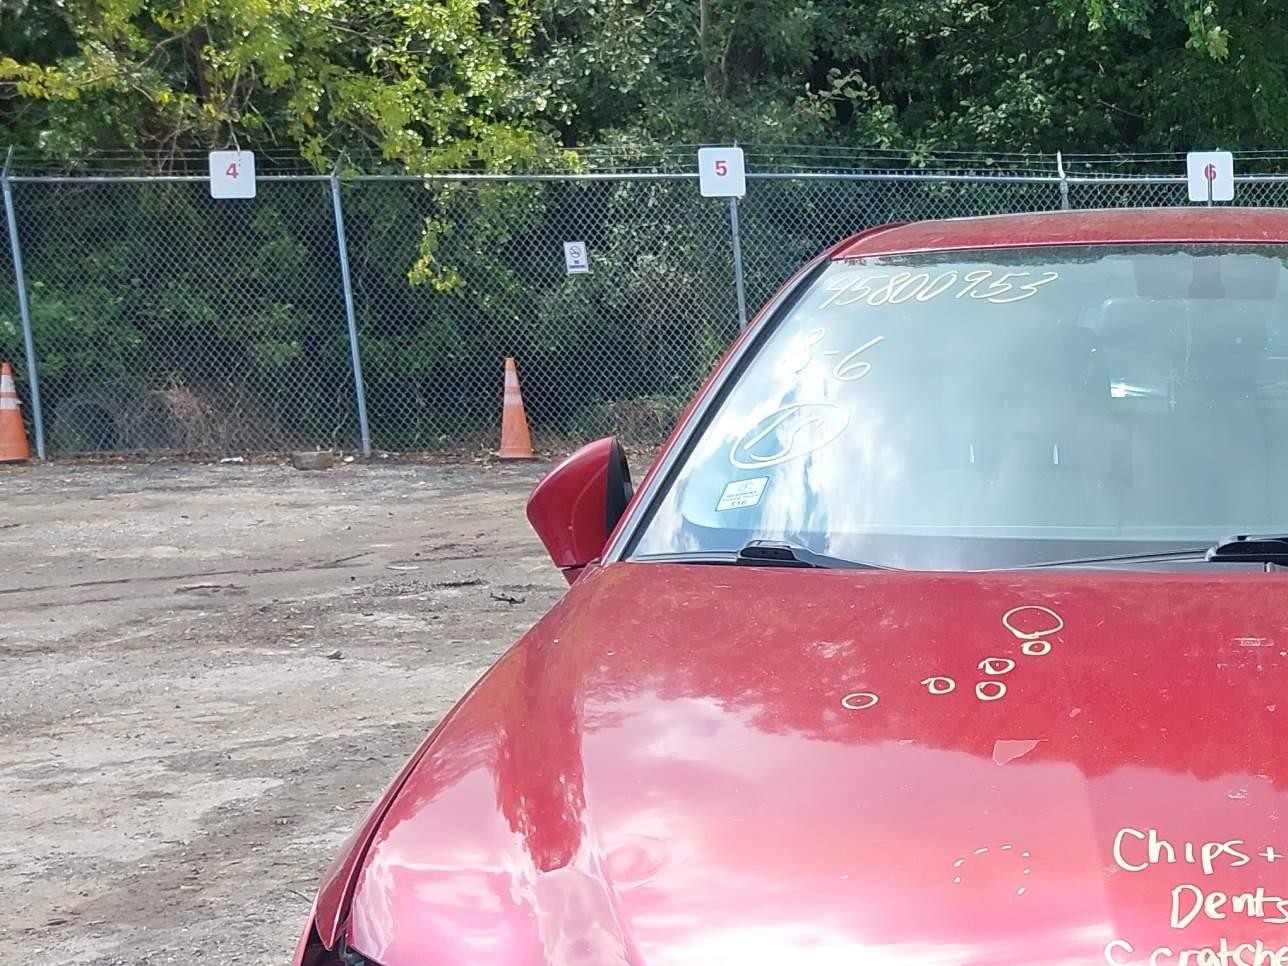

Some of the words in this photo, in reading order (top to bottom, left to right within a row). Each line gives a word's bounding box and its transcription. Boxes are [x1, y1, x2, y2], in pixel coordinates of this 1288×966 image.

[226, 163, 239, 178] 4
[715, 161, 727, 176] 5
[1204, 164, 1217, 180] 6
[818, 269, 1060, 310] 45800953
[1112, 827, 1252, 876] Chips
